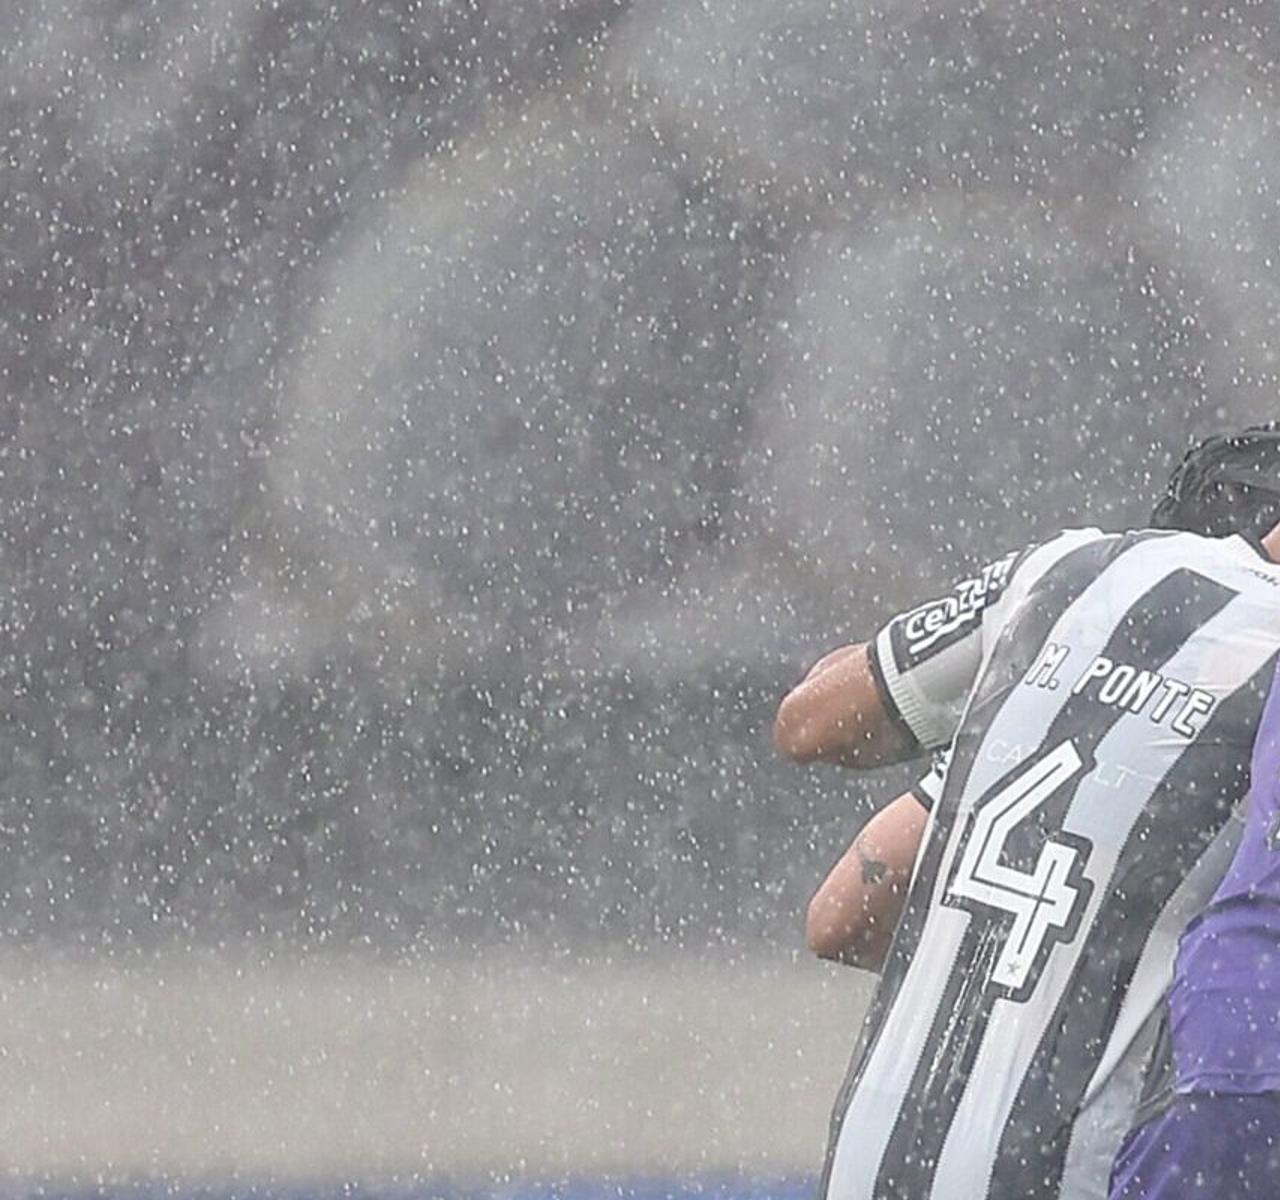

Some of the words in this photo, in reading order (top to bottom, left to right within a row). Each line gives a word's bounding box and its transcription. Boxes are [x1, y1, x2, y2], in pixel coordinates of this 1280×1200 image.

[1025, 642, 1067, 690] M.
[1073, 655, 1214, 738] PONTE
[950, 738, 1083, 989] 4
